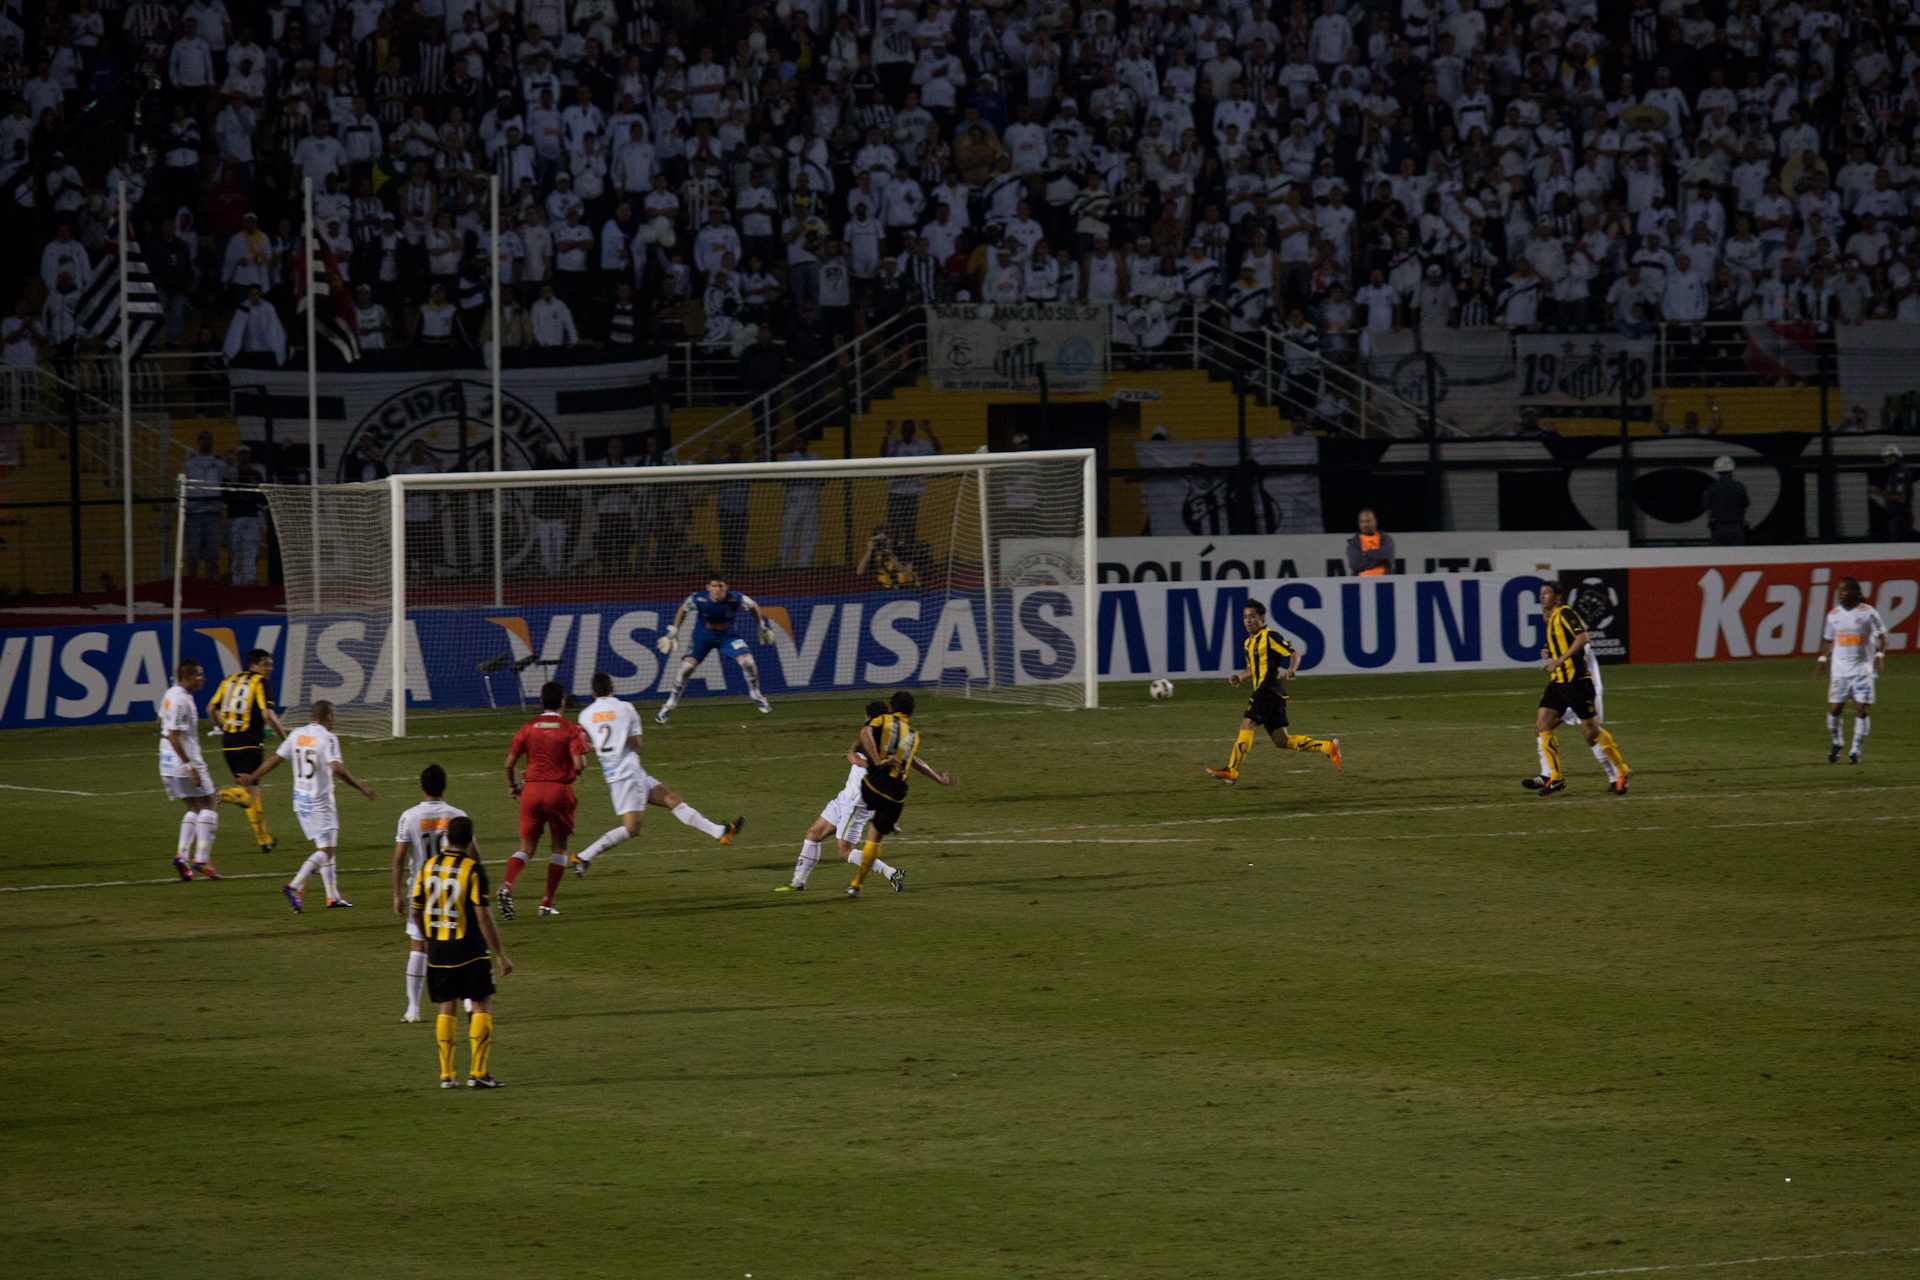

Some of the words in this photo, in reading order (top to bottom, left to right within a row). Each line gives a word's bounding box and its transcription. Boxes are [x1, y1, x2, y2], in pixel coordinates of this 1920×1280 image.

[485, 606, 727, 697] VISA
[760, 599, 987, 688] VISA
[1020, 576, 1550, 681] SAMSUNG
[194, 619, 432, 712] VISA
[220, 681, 250, 714] 18
[295, 748, 315, 779] 15
[599, 723, 613, 752] 2
[424, 875, 462, 917] 22
